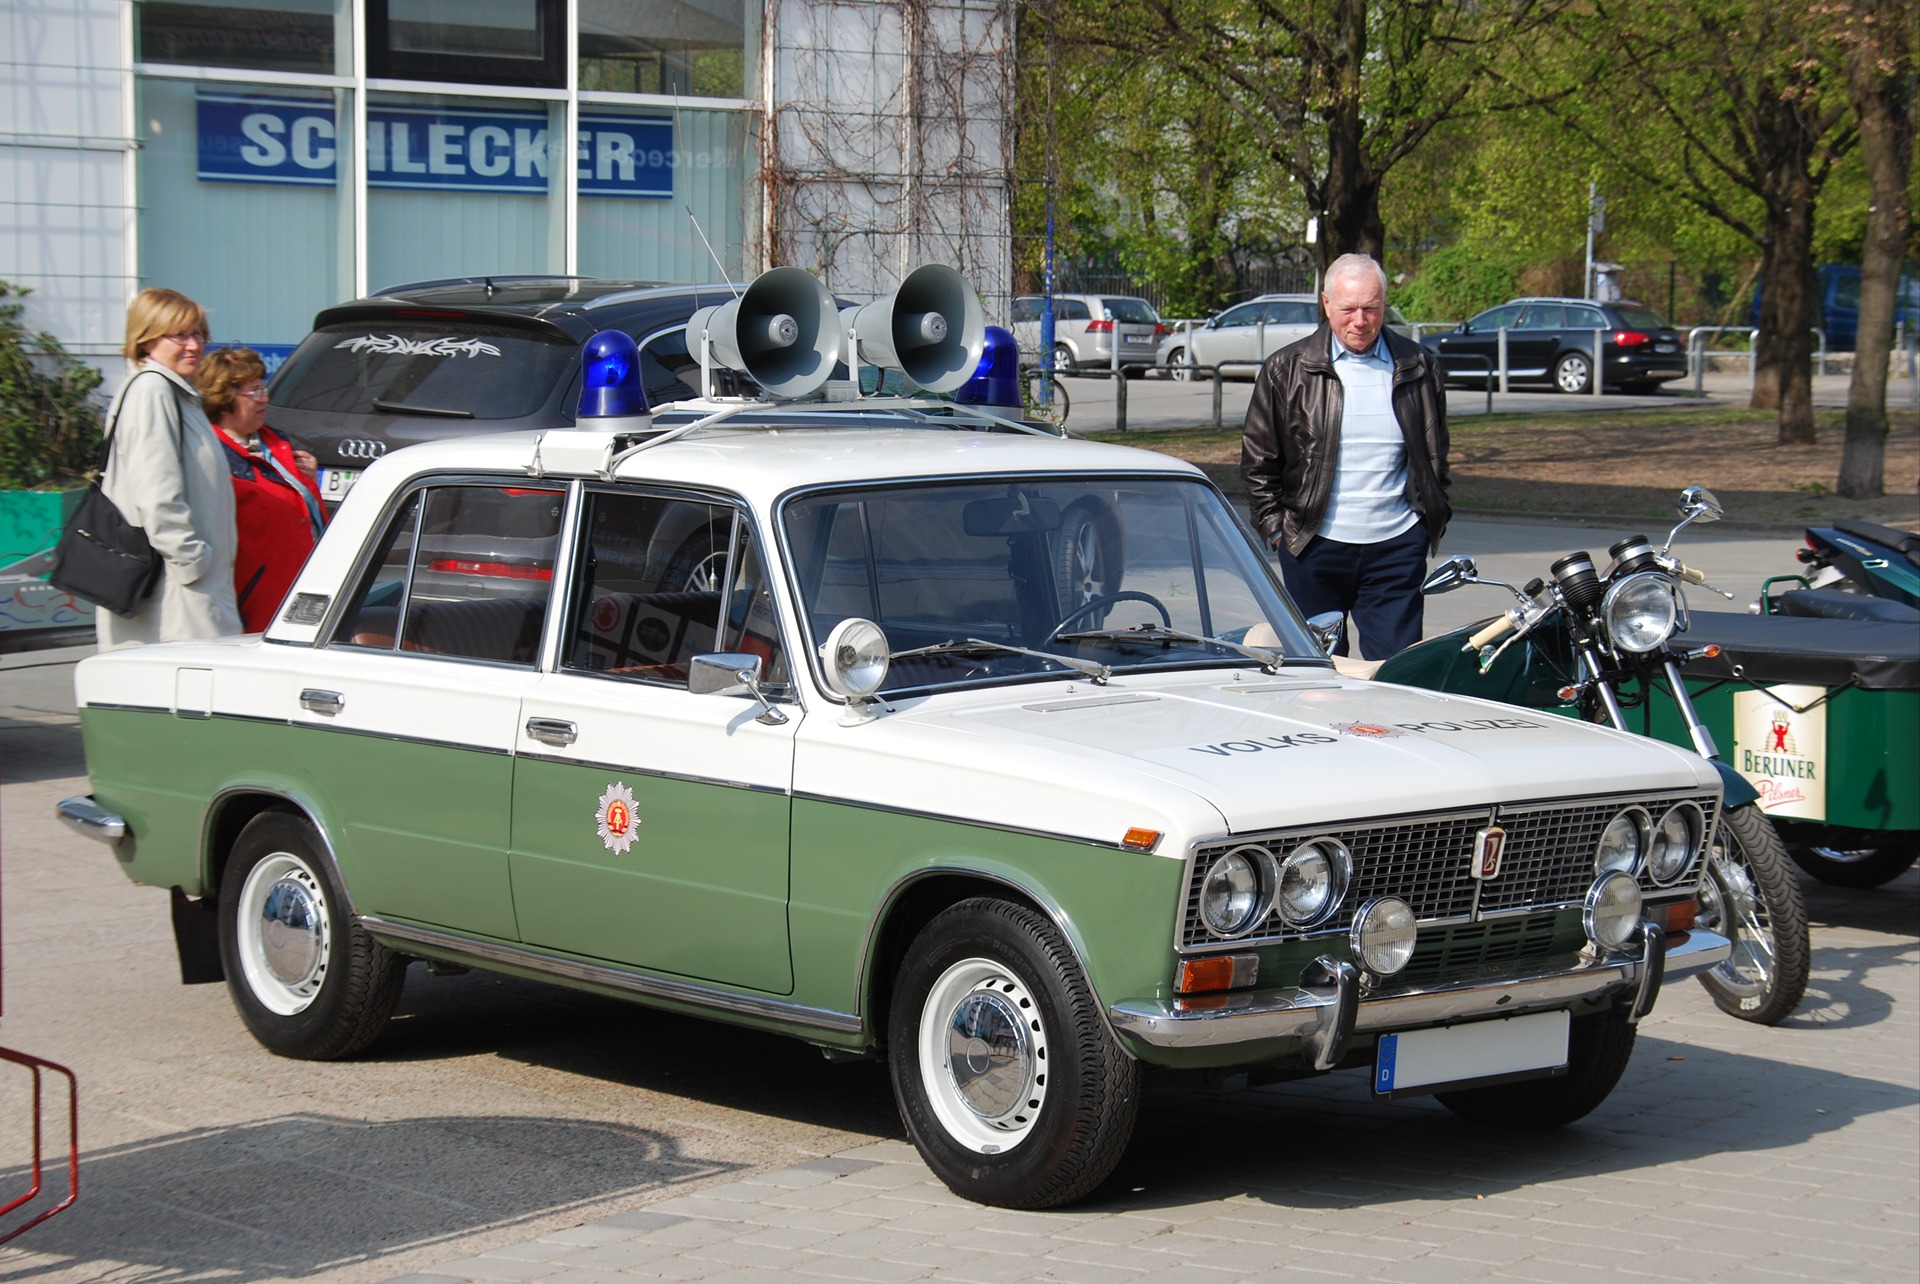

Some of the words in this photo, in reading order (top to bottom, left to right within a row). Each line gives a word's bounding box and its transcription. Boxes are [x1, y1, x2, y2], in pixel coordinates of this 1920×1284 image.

[330, 471, 340, 491] B
[1188, 733, 1338, 757] VOLKS
[1398, 719, 1547, 734] POLIZEI
[1744, 749, 1816, 780] BERLINER
[1752, 779, 1806, 806] Pilsner
[1381, 1069, 1389, 1081] D
